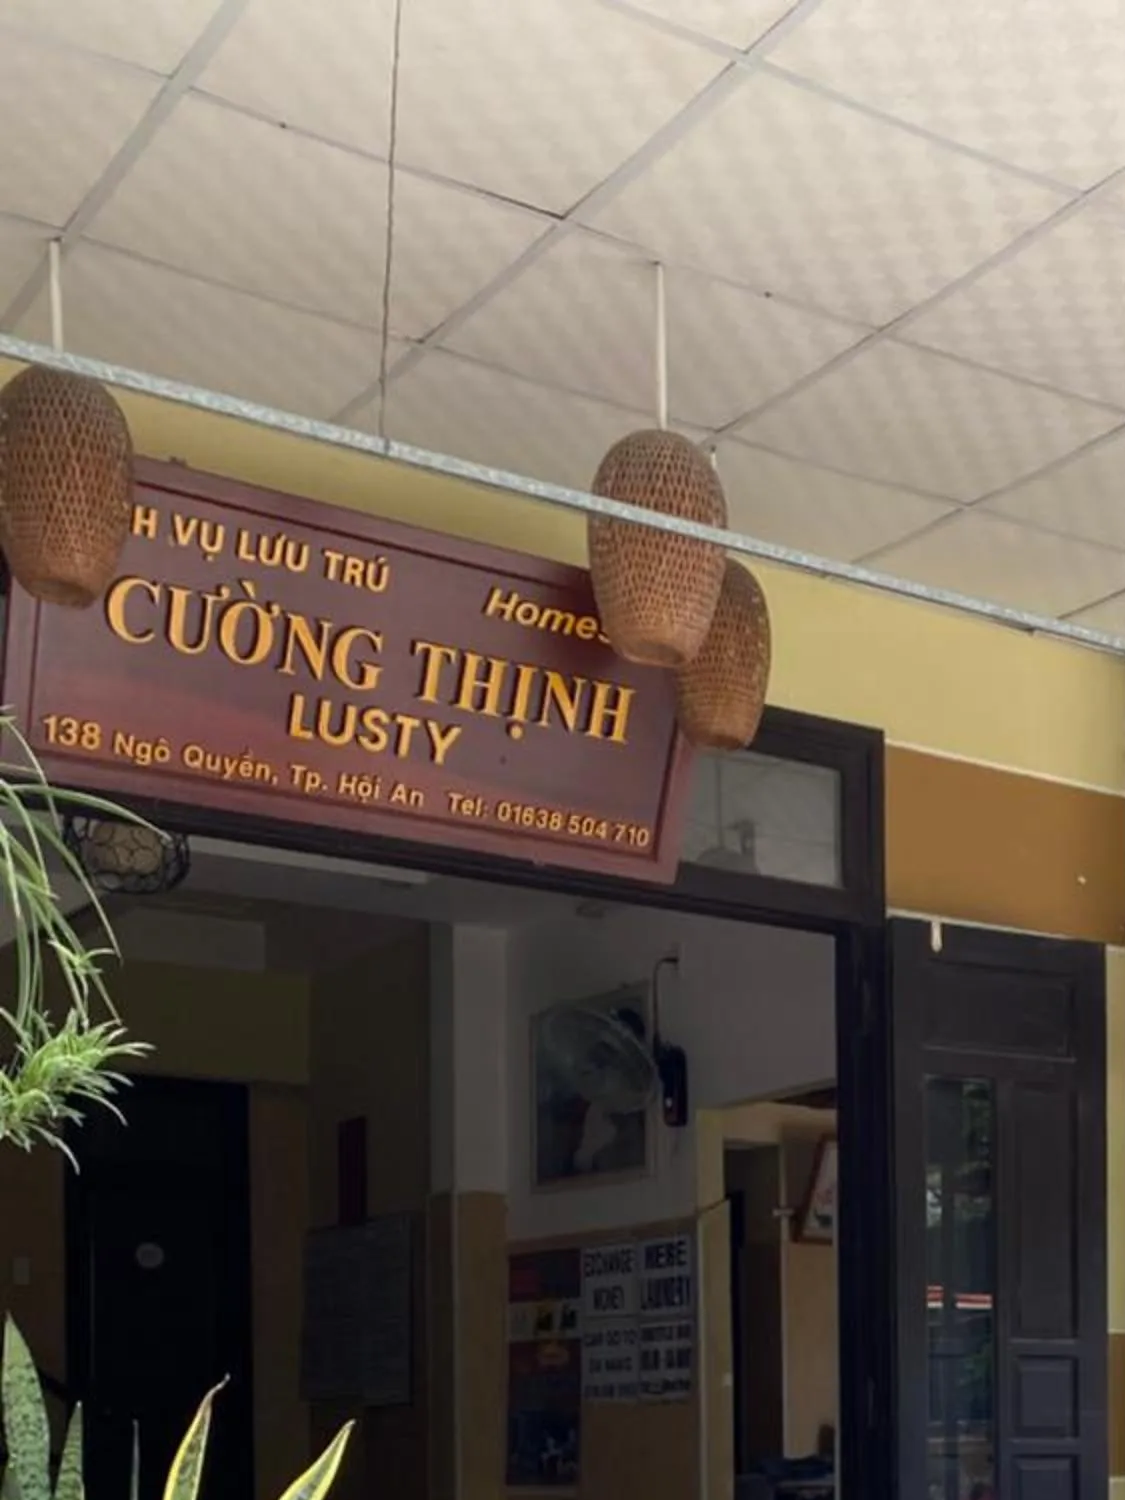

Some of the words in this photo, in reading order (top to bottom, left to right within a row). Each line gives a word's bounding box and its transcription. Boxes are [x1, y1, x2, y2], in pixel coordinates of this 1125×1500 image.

[173, 513, 226, 563] VỤ
[324, 549, 392, 593] TRÚ
[484, 586, 612, 645] Home
[107, 576, 385, 691] CƯỜNG
[413, 641, 637, 745] THỊNH
[289, 693, 463, 766] LUSTY
[43, 714, 102, 752] 138
[113, 731, 172, 767] Ngô
[290, 763, 329, 794] Tp.
[338, 771, 382, 805] Hội
[390, 783, 425, 809] An
[497, 801, 562, 833] 01638
[567, 814, 609, 841] 504
[613, 823, 651, 849] 710
